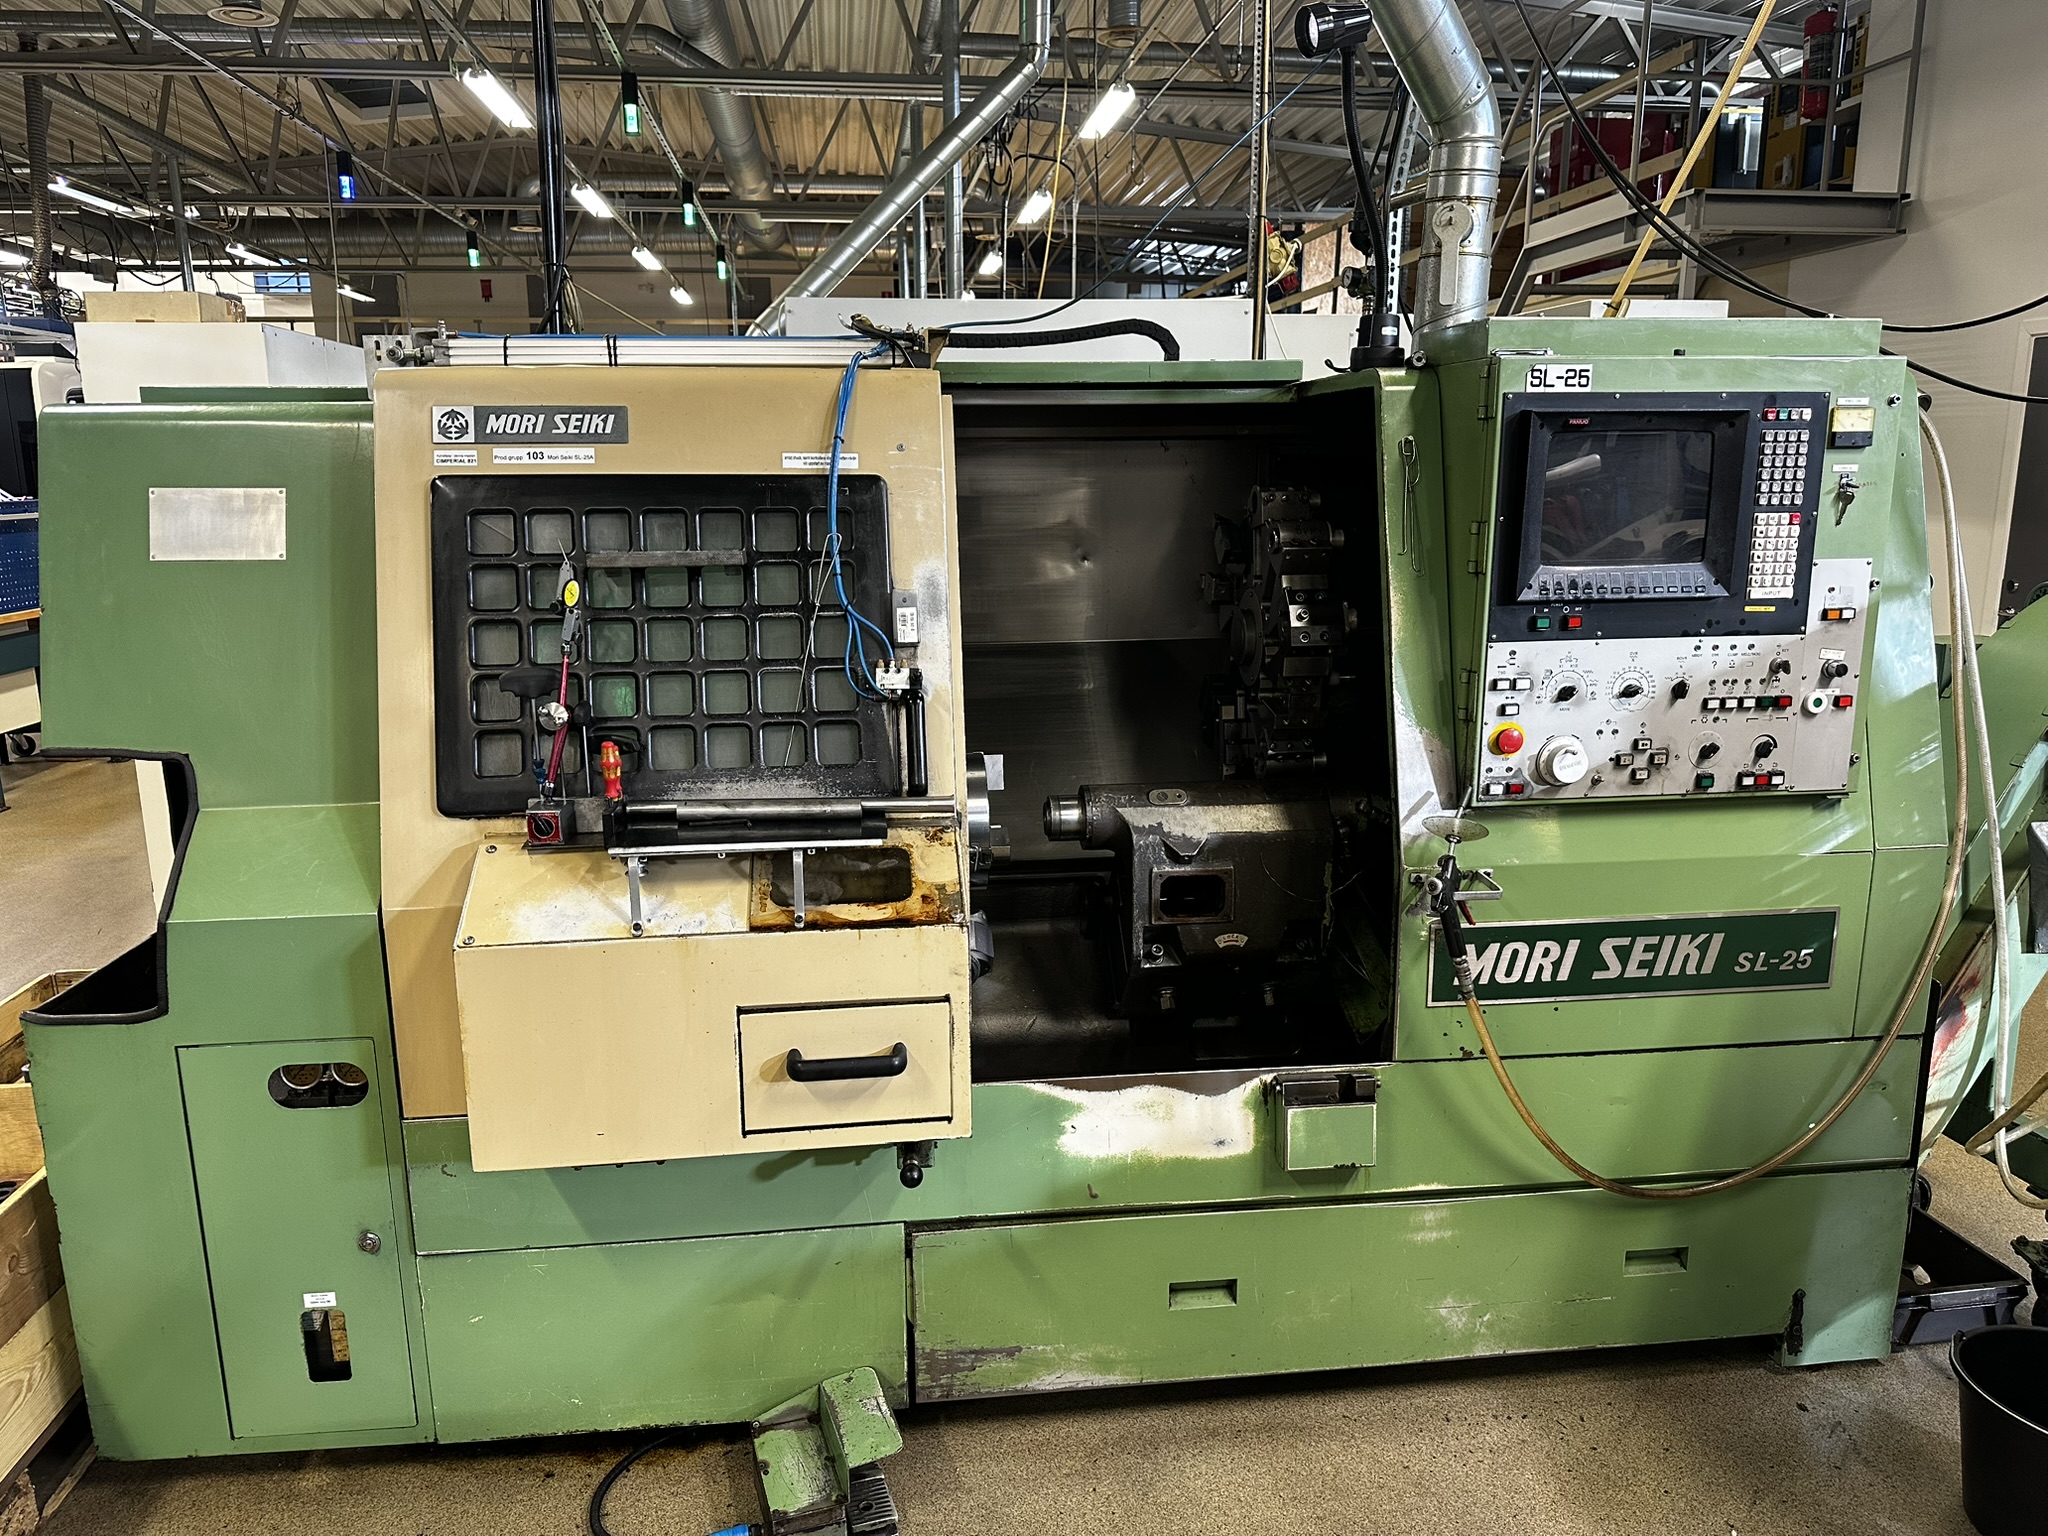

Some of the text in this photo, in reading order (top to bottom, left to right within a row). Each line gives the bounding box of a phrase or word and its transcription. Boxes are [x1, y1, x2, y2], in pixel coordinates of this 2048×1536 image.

[1530, 369, 1591, 387] SL-25
[485, 413, 615, 434] MORI SEIKI
[526, 451, 545, 460] 103
[1453, 932, 1815, 985] MORI SEIKI SL-25
